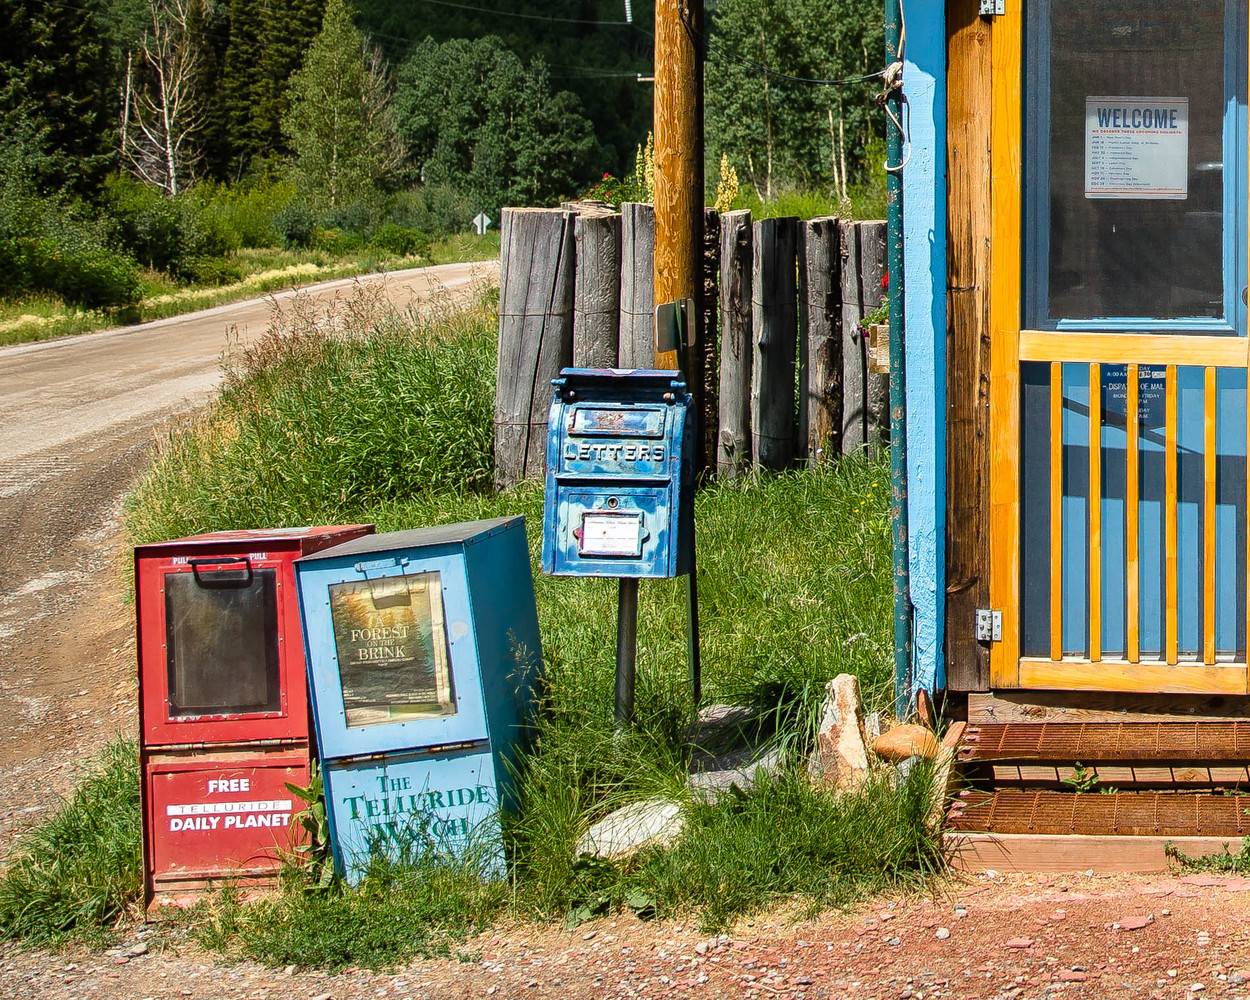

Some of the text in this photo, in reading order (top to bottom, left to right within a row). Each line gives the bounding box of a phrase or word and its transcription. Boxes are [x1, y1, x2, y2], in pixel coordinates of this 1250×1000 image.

[1097, 107, 1178, 129] WELCOME
[563, 443, 665, 462] LETTERS
[249, 552, 267, 560] PULL
[375, 616, 384, 628] A
[350, 625, 410, 642] FOREST
[358, 644, 407, 661] BRINK
[208, 778, 250, 793] FREE
[376, 775, 412, 793] THE
[180, 801, 281, 814] TELLURIDE
[170, 813, 292, 832] DAILY PLANET
